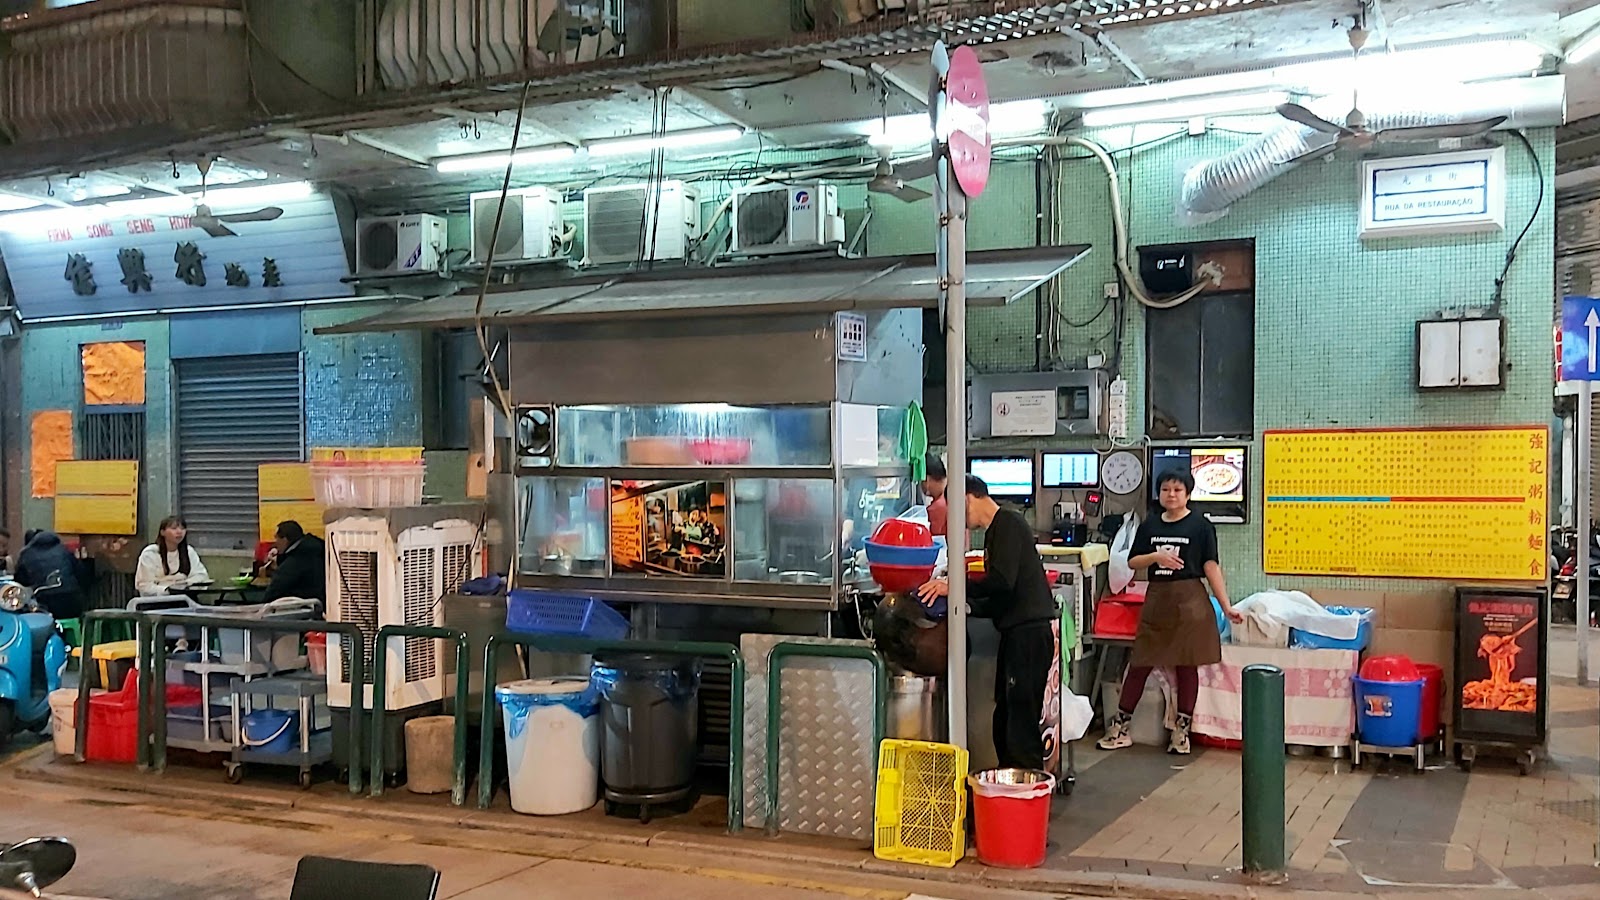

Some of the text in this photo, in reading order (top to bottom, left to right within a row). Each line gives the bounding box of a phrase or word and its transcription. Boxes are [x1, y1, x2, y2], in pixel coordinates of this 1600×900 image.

[1384, 197, 1473, 211] RUA DA RESTAURAÇÃO
[47, 227, 73, 242] FIRMA
[86, 222, 114, 239] SONG
[126, 218, 156, 235] SENG
